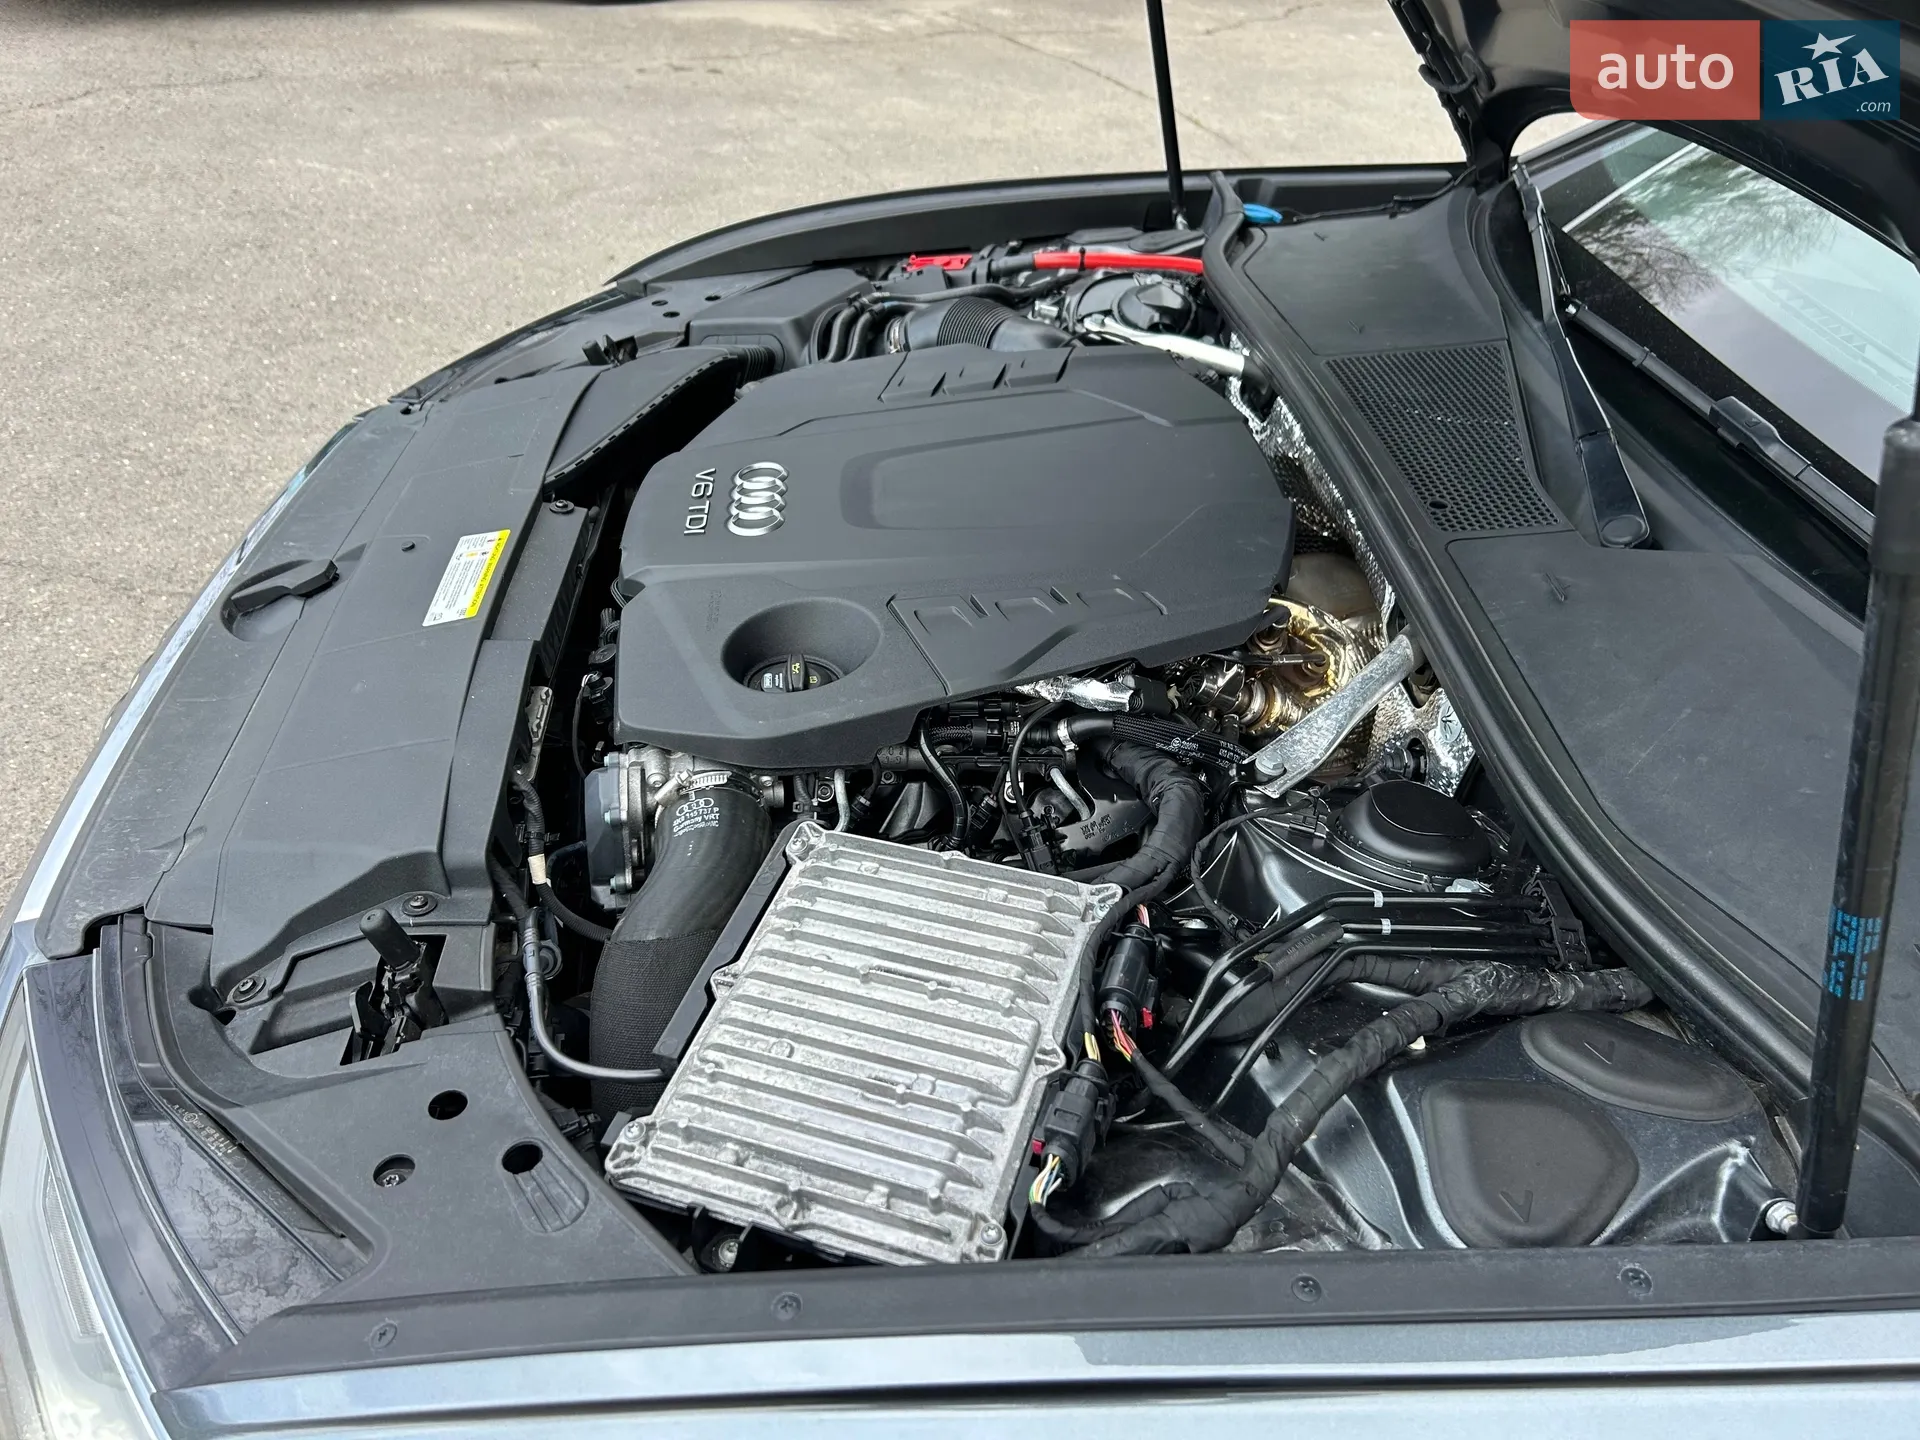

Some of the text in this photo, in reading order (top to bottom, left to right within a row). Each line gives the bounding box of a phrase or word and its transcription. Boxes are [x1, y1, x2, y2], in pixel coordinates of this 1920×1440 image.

[684, 468, 716, 535] V6 TDI
[673, 816, 702, 832] Germany
